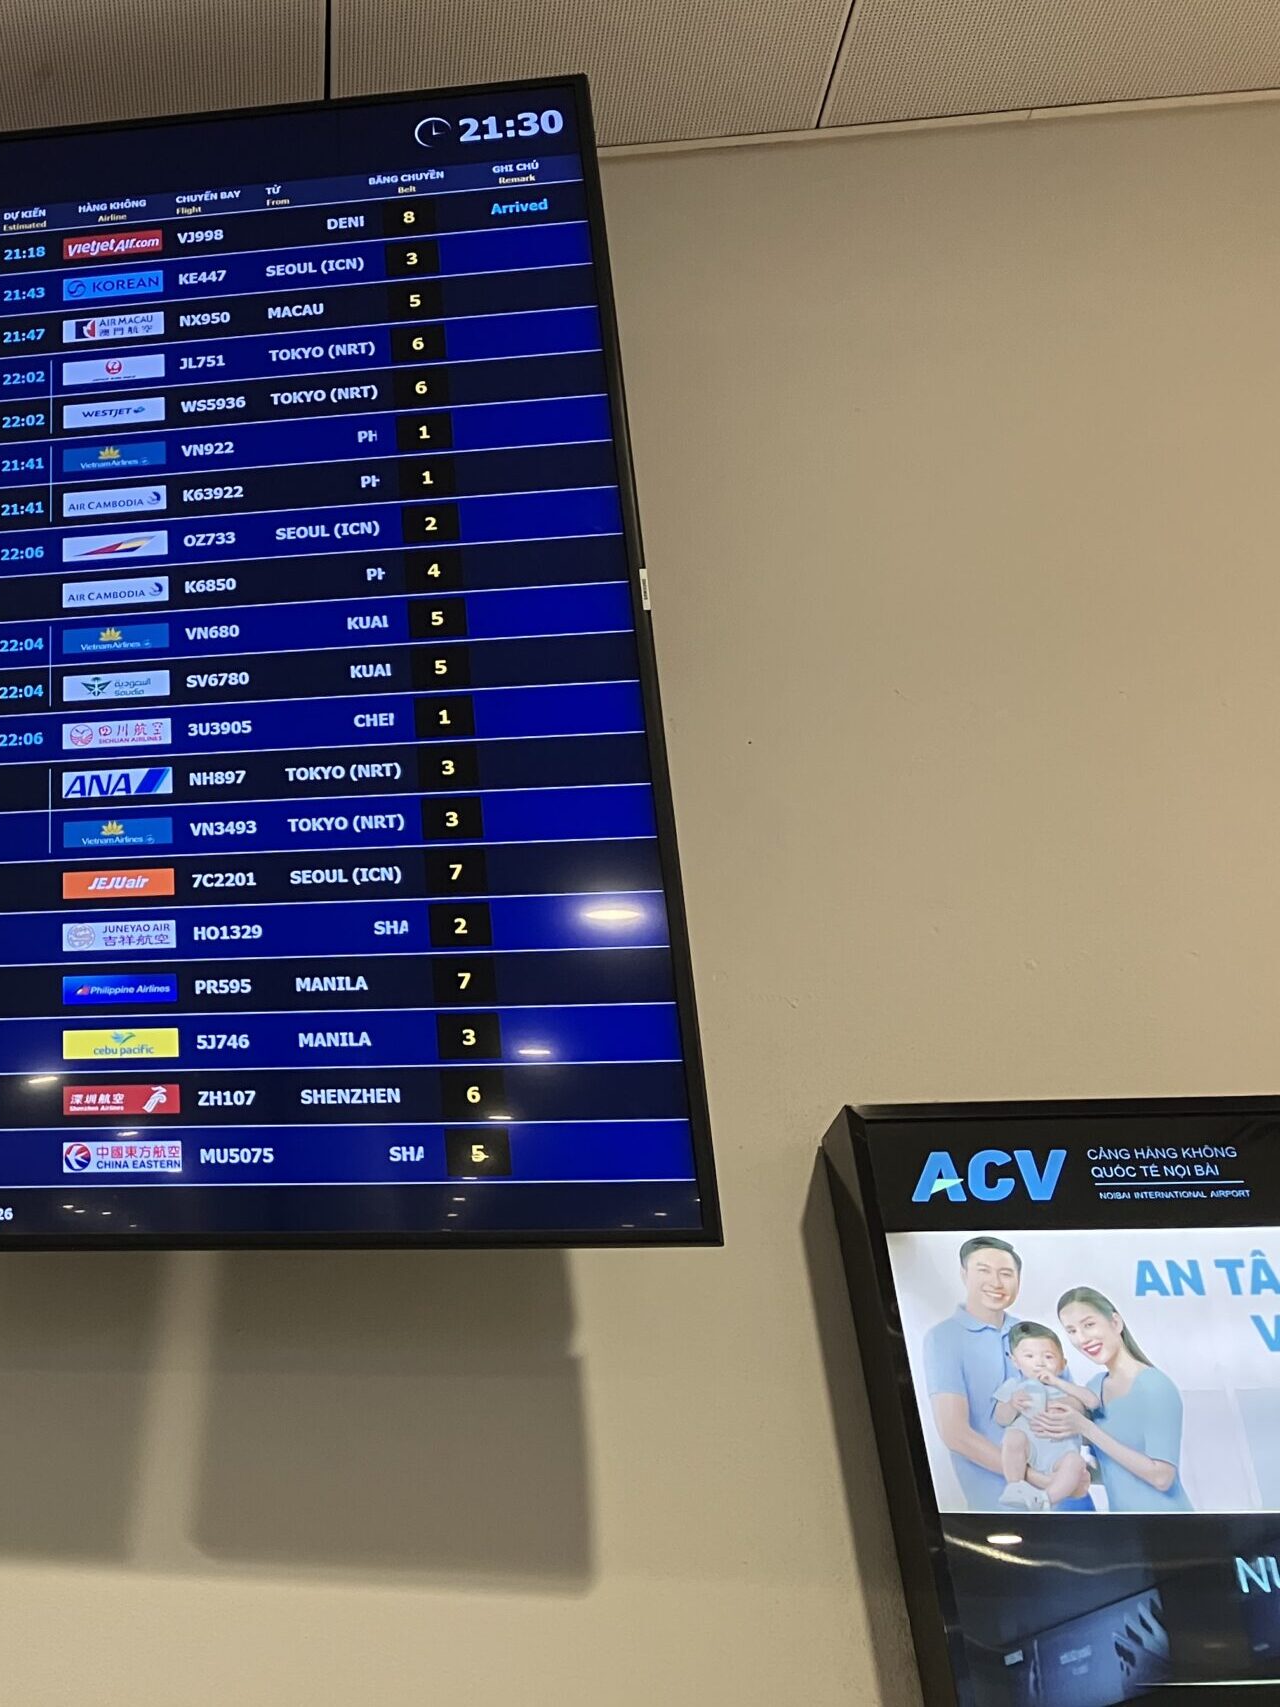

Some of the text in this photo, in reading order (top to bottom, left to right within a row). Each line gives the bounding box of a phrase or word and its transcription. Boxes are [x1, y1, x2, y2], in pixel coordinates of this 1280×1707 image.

[458, 109, 564, 143] 21:30
[499, 174, 536, 185] Remark
[398, 185, 416, 194] Belt
[97, 213, 128, 223] Airline
[176, 205, 202, 216] Flight
[3, 220, 47, 232] Estimated
[176, 228, 224, 244] VJ998
[91, 256, 365, 293] KOREAN KE447 SEOUL (ICN)
[179, 302, 324, 327] NX950 MACAU
[179, 341, 376, 370] JL751 TOKYO (NRT)
[81, 395, 247, 418] WESTJET WS5936
[182, 485, 244, 502] K63922
[183, 531, 236, 547] OZ733
[186, 671, 250, 689] SV6780
[187, 720, 253, 737] 3U3905
[64, 769, 247, 798] ANA NH897
[189, 820, 258, 837] VN3493
[87, 875, 150, 890] JEJUair
[191, 871, 257, 889] 7C2201
[102, 923, 263, 941] JUNEYAO AIR HO1329
[102, 934, 171, 947] 吉祥航空
[90, 975, 369, 996] Philippine Airlines PR595 MANILA
[93, 1033, 250, 1057] cebu pacific 5J746
[197, 1089, 257, 1107] ZH107
[300, 1087, 401, 1105] SHENZHEN
[466, 1085, 481, 1104] 6
[96, 1145, 181, 1159] 中國東方航空
[96, 1147, 275, 1170] CHINA EASTERN MU5075
[1086, 1144, 1238, 1161] CẢNG HÀNG KHÔNG
[911, 1149, 1068, 1203] ACV
[1194, 1161, 1220, 1177] BÀI
[1099, 1189, 1251, 1200] NOIBAI INTERNATIONAL AIRPORT
[1134, 1258, 1207, 1298] AN
